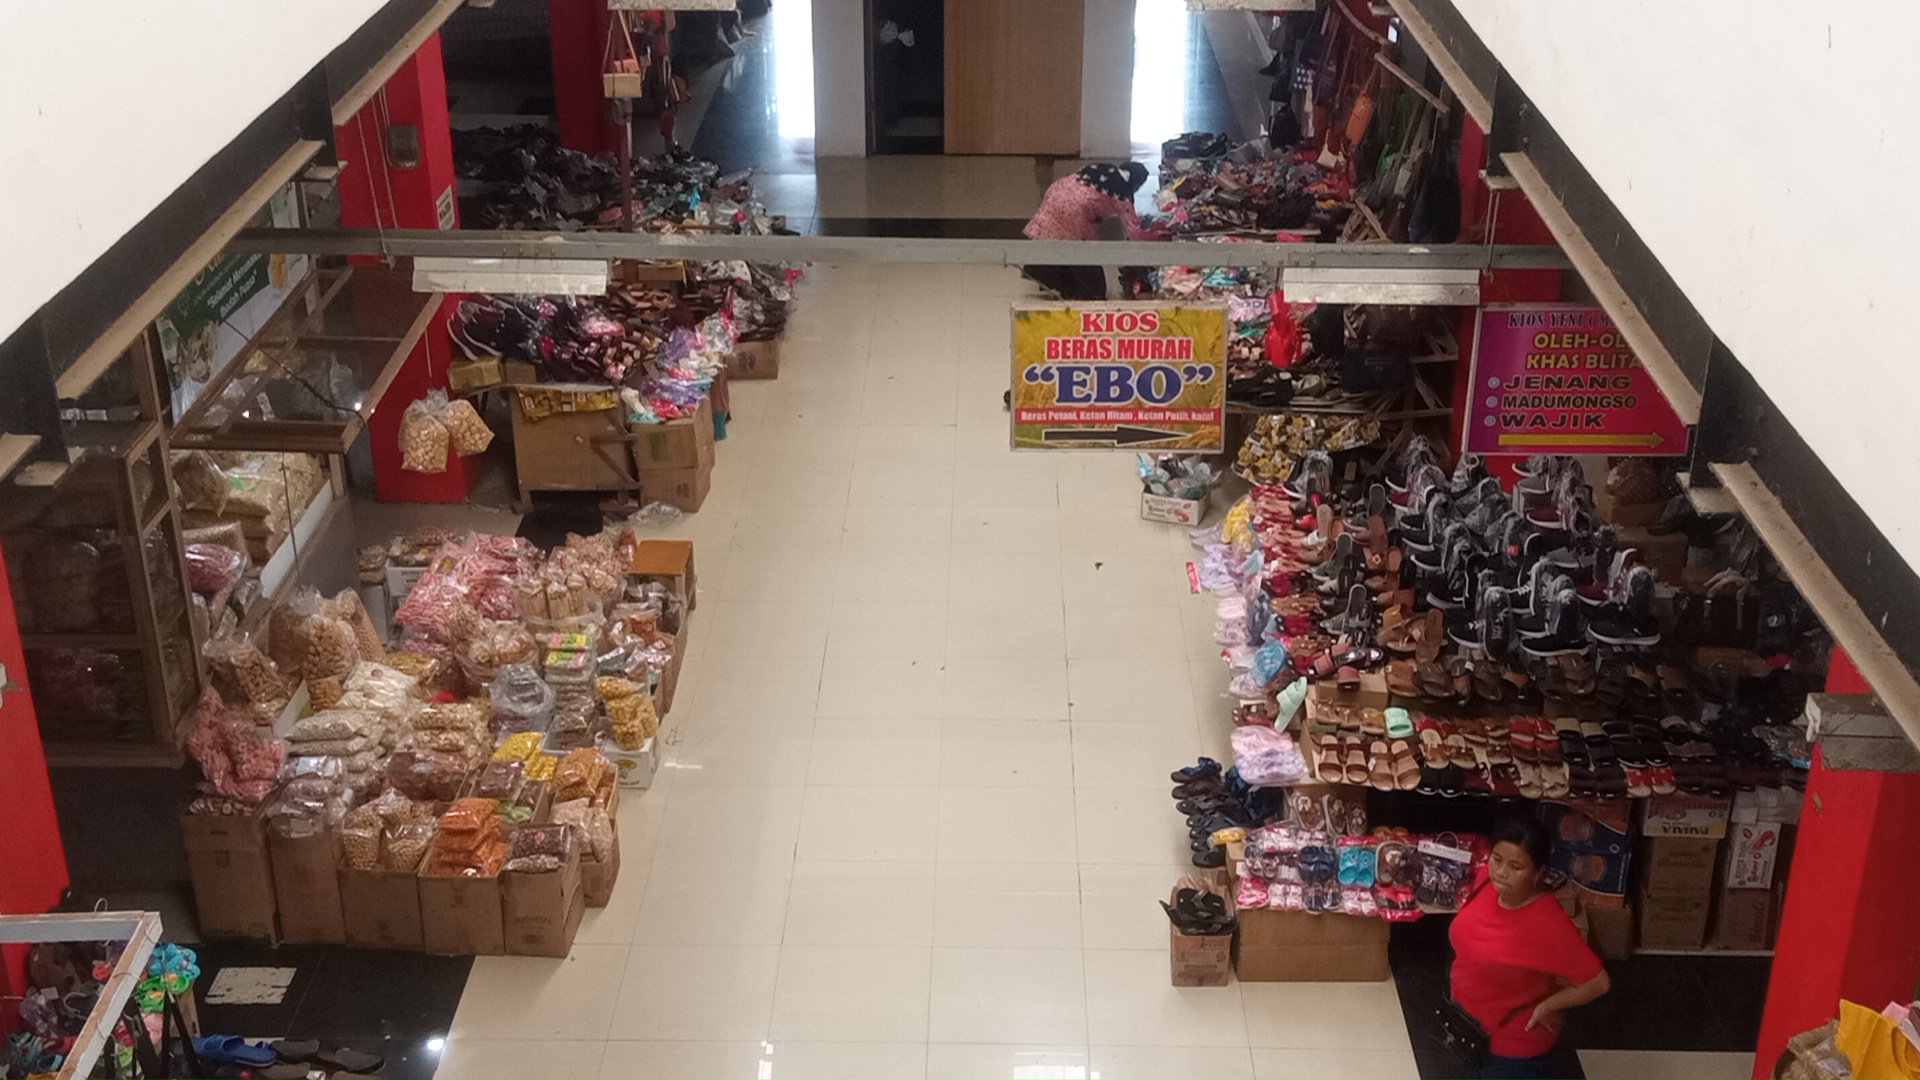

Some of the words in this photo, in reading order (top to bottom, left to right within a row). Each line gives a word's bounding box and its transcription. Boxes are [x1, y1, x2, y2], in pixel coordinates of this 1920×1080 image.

[1082, 312, 1159, 332] KIOS
[1508, 312, 1545, 328] KIOS
[1549, 312, 1585, 328] YENI
[1533, 332, 1634, 349] OLEH-OL
[1046, 338, 1113, 360] BERAS
[1117, 338, 1193, 360] MURAH
[1526, 353, 1580, 369] KHAS
[1504, 375, 1631, 390] JENANG
[1502, 394, 1637, 409] MADUMONGSO
[1021, 410, 1047, 420] Beras
[1080, 410, 1106, 420] Ketan
[1138, 410, 1164, 420] Ketan
[1500, 413, 1606, 429] WAJIK
